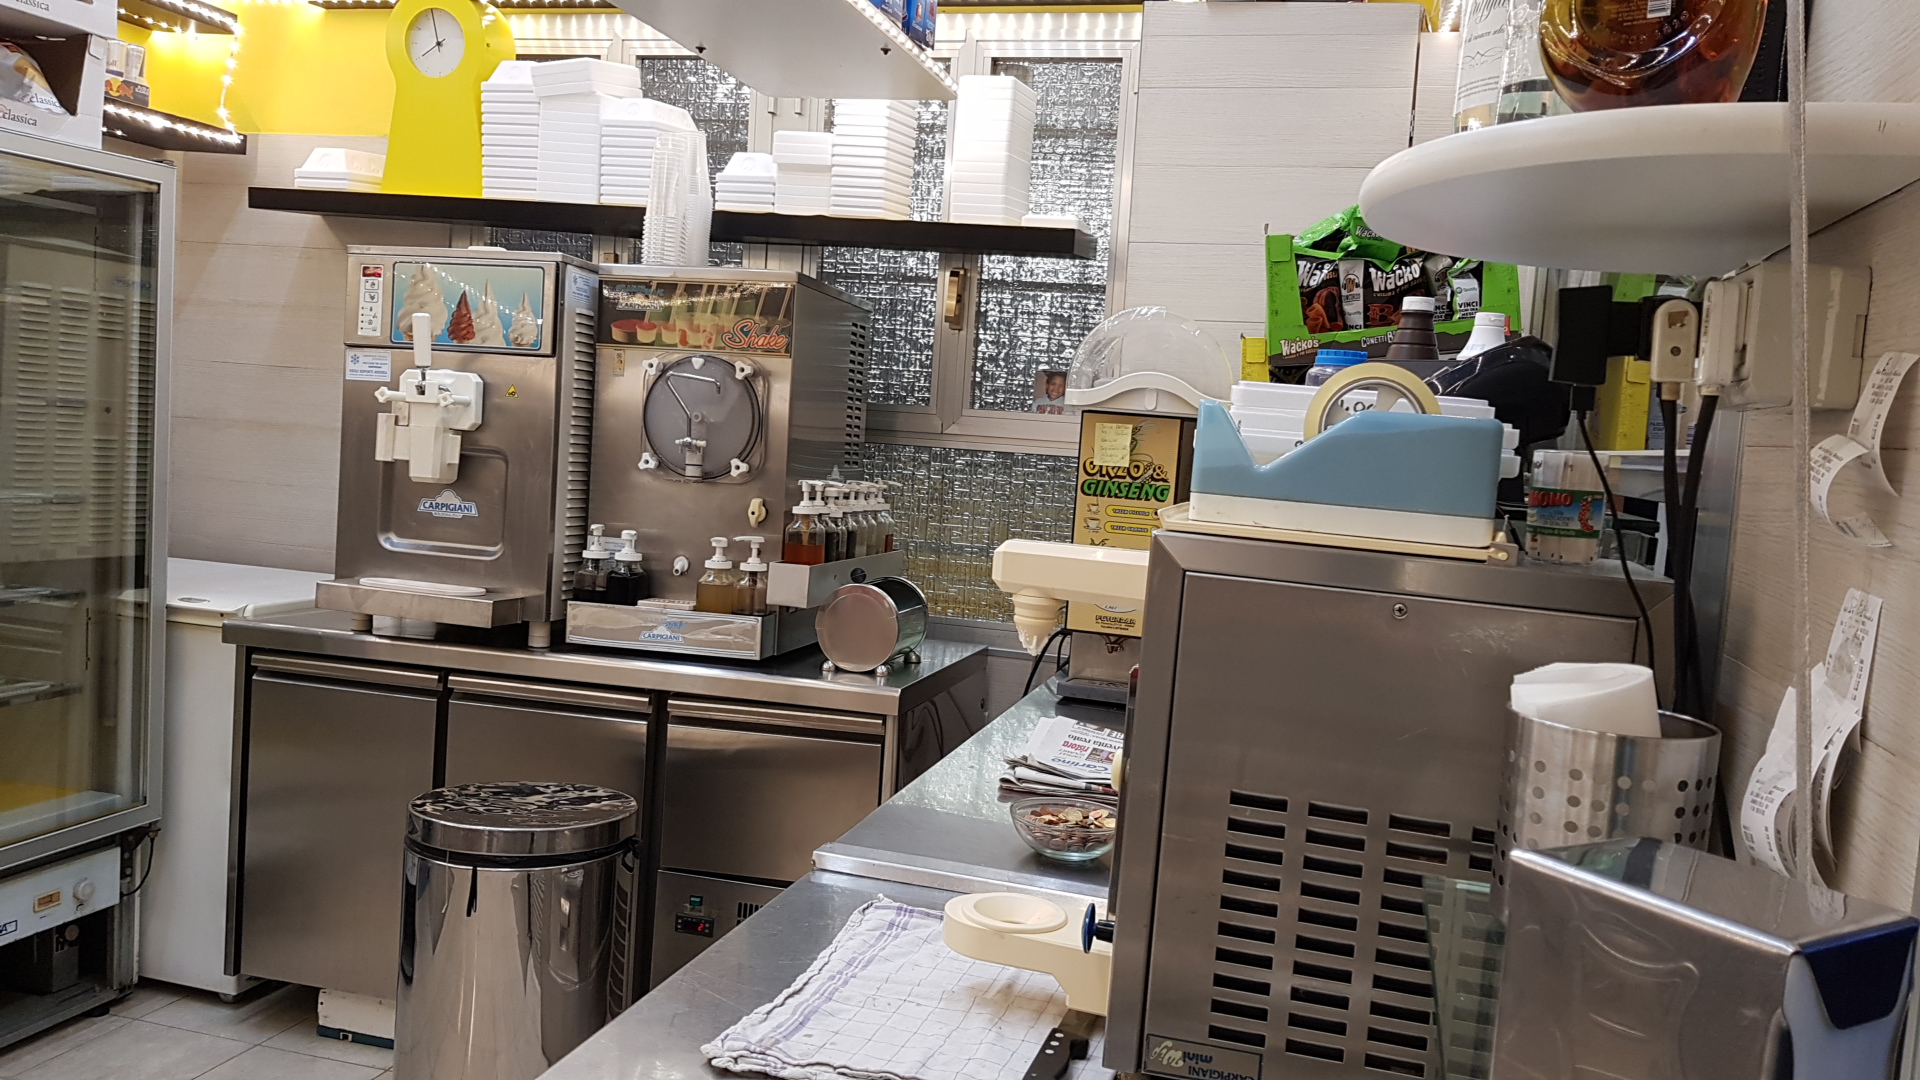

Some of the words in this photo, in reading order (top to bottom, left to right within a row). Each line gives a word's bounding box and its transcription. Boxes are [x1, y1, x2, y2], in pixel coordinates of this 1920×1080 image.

[29, 93, 62, 109] classic
[3, 108, 38, 127] classica
[1458, 301, 1478, 309] VINCI
[721, 317, 791, 350] Shake
[1360, 335, 1386, 348] CONETTI
[1387, 331, 1396, 344] B
[1152, 464, 1169, 481] &
[1081, 478, 1170, 501] GINSENG
[422, 501, 473, 513] CARPIGIANI
[642, 632, 680, 641] CARPIGIANI
[1062, 740, 1090, 753] ristora
[1067, 734, 1092, 746] reato
[1051, 757, 1109, 772] Carlino
[697, 923, 705, 932] 2
[1183, 1051, 1213, 1065] mini
[1188, 1065, 1255, 1080] CARPIGIANI
